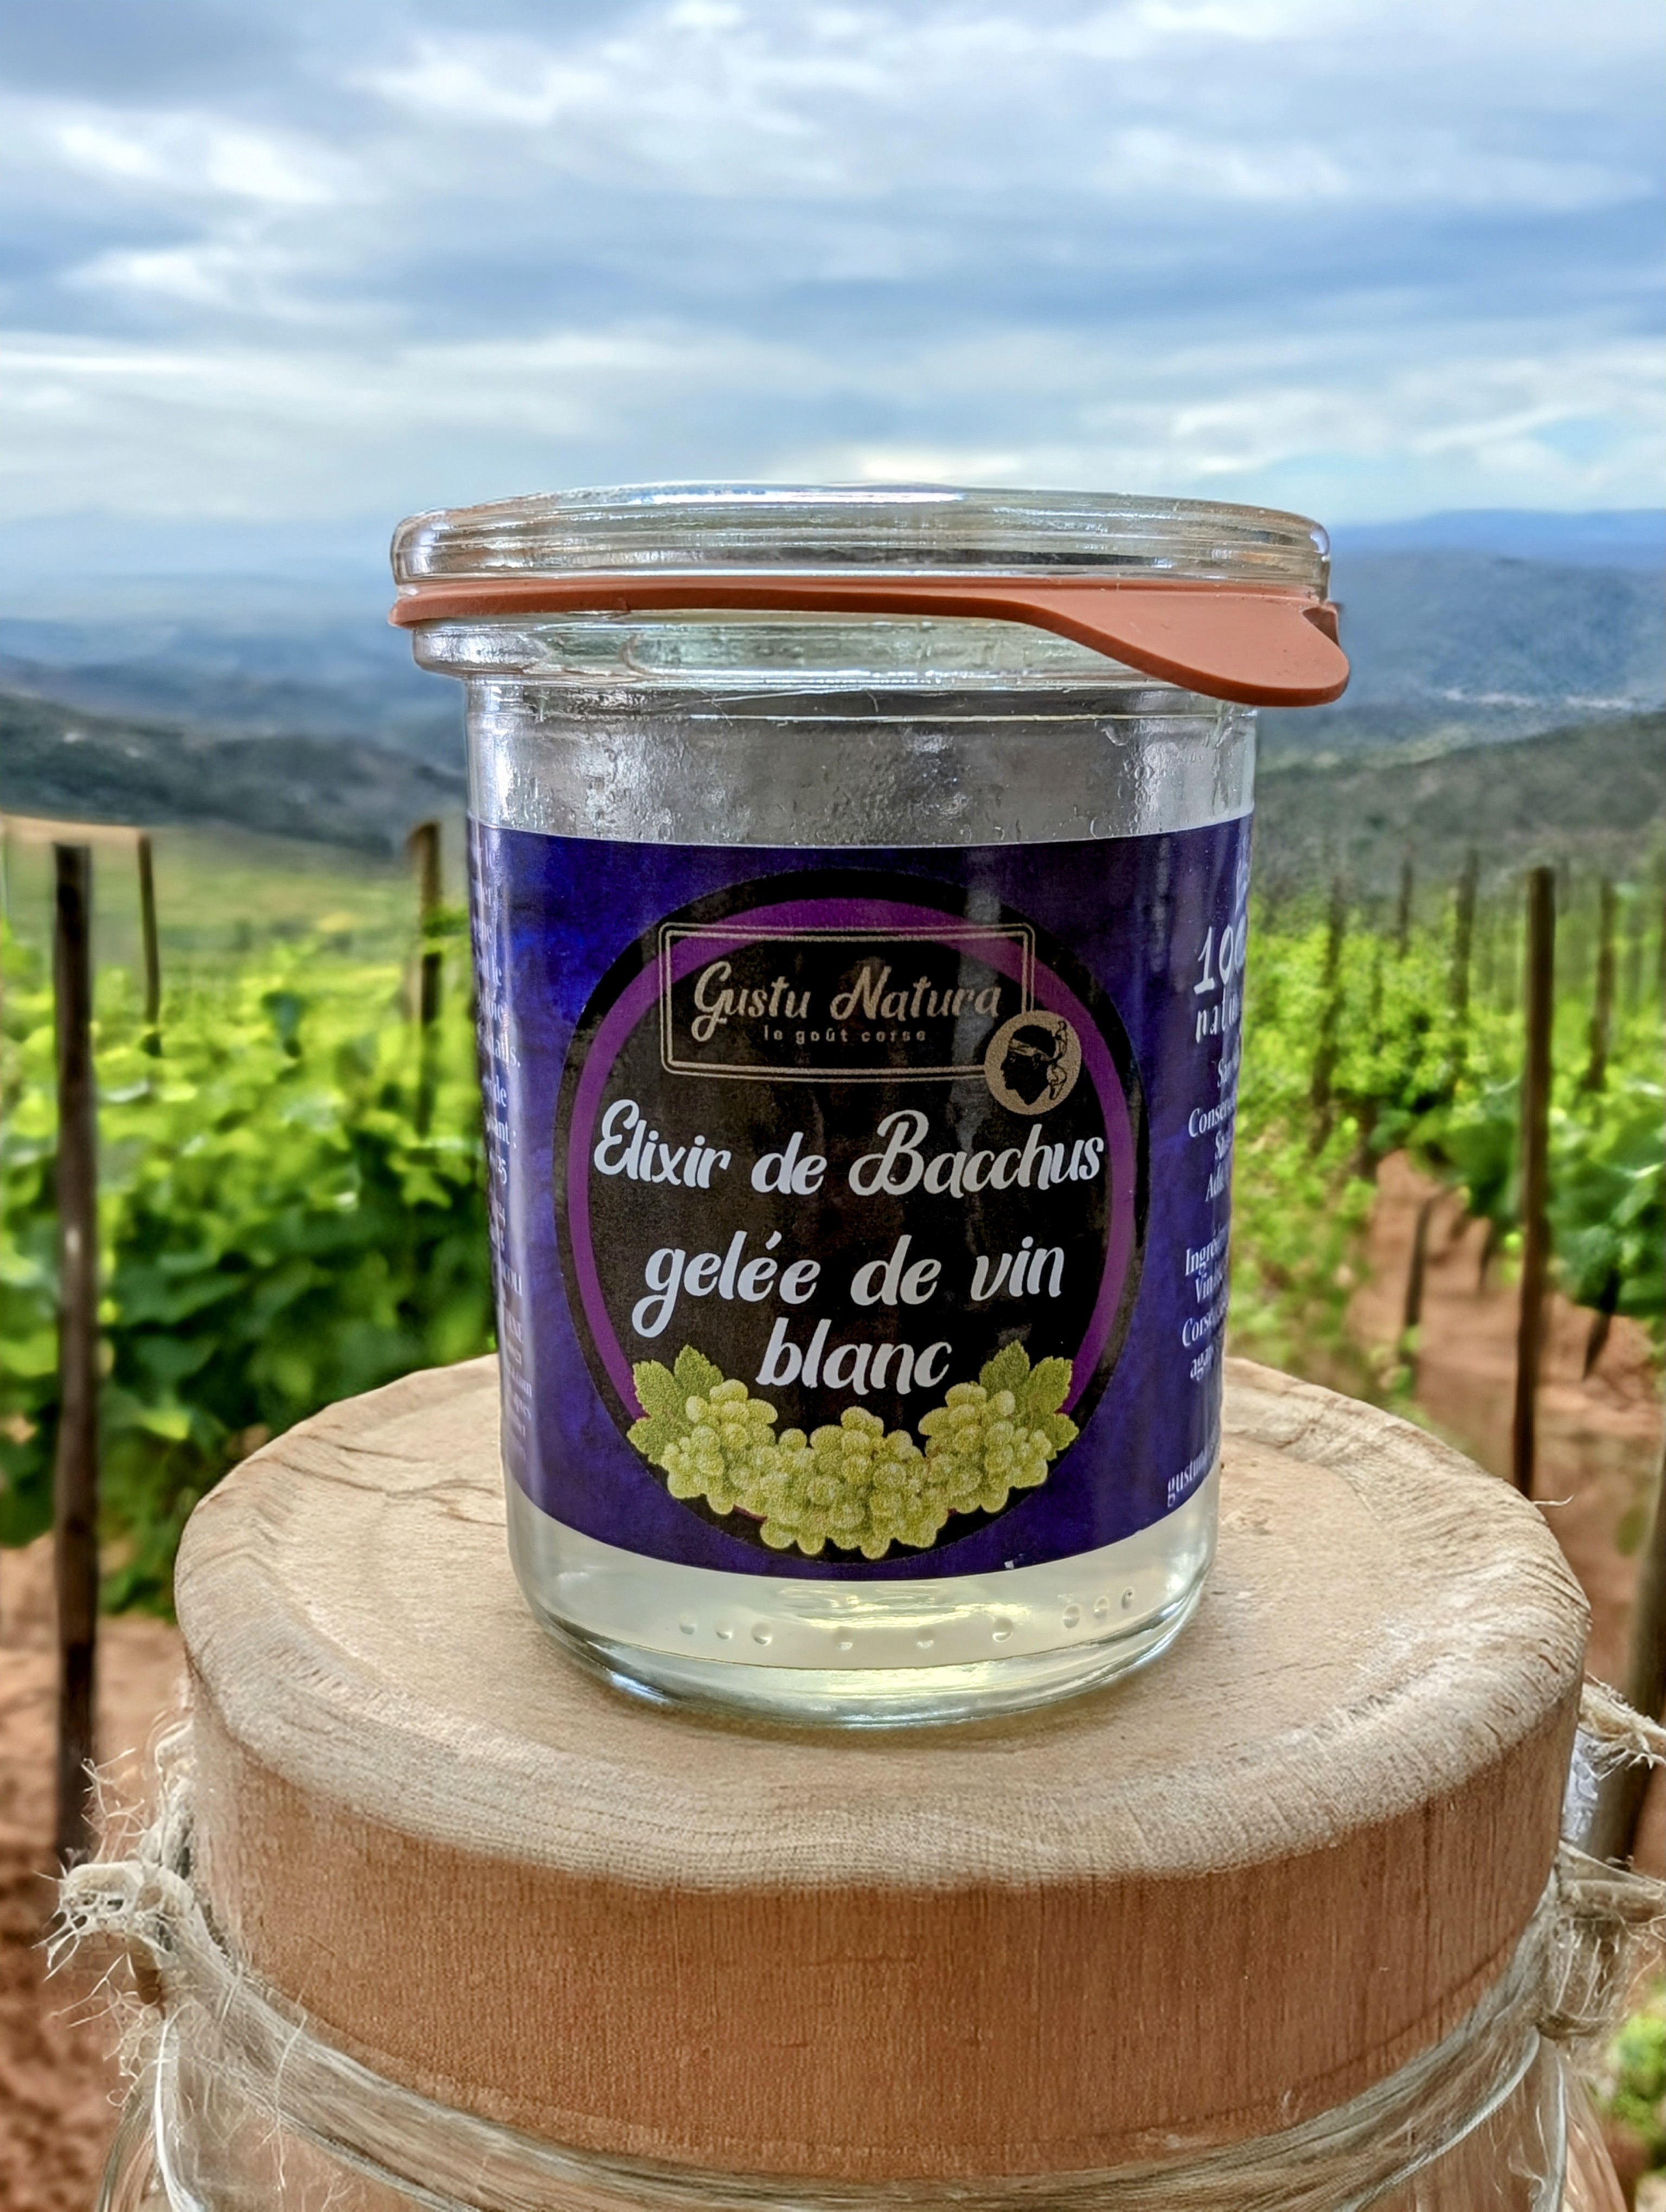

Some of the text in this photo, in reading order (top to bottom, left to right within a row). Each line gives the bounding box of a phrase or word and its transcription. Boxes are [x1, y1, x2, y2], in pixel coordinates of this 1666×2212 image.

[691, 961, 1001, 1041] Gustu Natura
[764, 1024, 926, 1045] le goût corse
[594, 1099, 731, 1188] Elixir
[751, 1131, 828, 1194] de
[848, 1110, 1103, 1198] Bacchus
[631, 1230, 1065, 1338] gelée de vin
[755, 1317, 952, 1394] blanc
